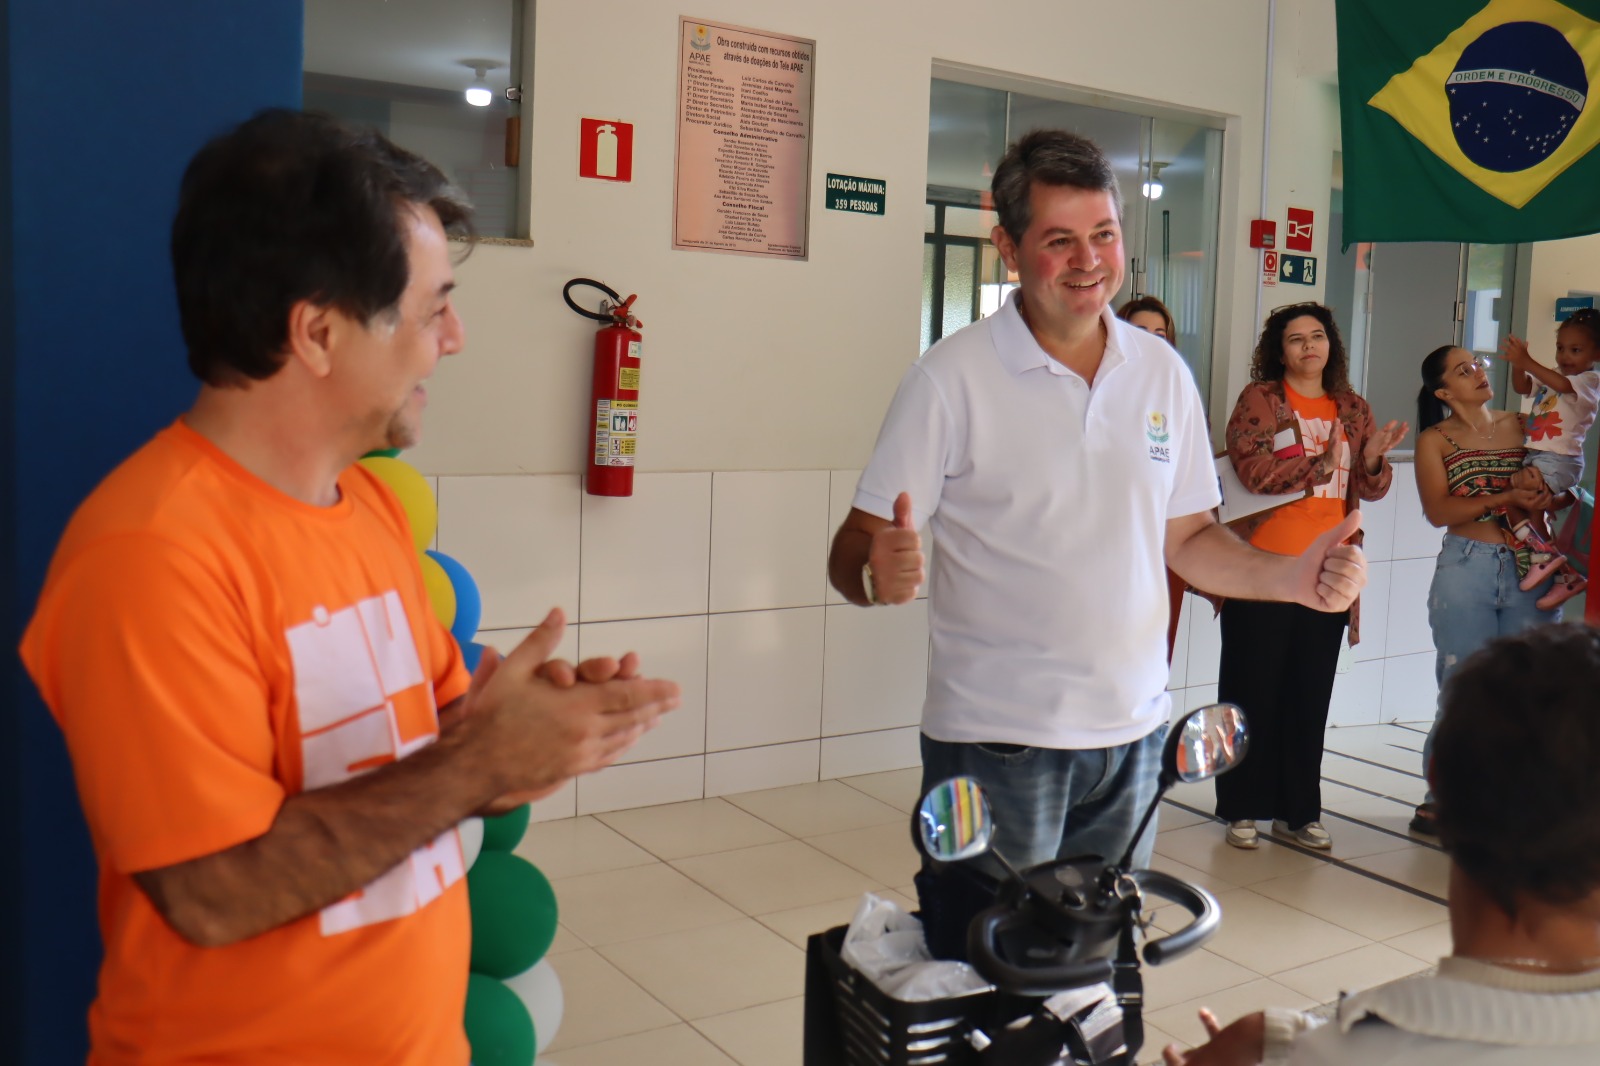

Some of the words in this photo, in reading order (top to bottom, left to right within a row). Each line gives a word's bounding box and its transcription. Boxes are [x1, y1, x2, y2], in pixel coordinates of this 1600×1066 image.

[717, 36, 729, 47] Obra
[758, 46, 768, 54] com
[770, 48, 790, 58] recursos
[792, 50, 809, 61] obtidos
[690, 52, 710, 62] APAE
[724, 52, 742, 62] através
[743, 55, 749, 63] de
[751, 57, 771, 68] doações
[772, 60, 778, 69] do
[780, 60, 789, 70] Tele
[790, 63, 803, 73] APAE
[1456, 71, 1494, 82] ORDEM
[1499, 72, 1505, 80] E
[1509, 73, 1580, 103] PROGRESSO
[740, 133, 778, 142] Administrativo
[828, 178, 856, 192] LOTAÇÃO
[858, 180, 885, 194] MÁXIMA:
[835, 199, 848, 209] 359
[850, 200, 878, 212] PESSOAS
[1150, 446, 1169, 458] APAE
